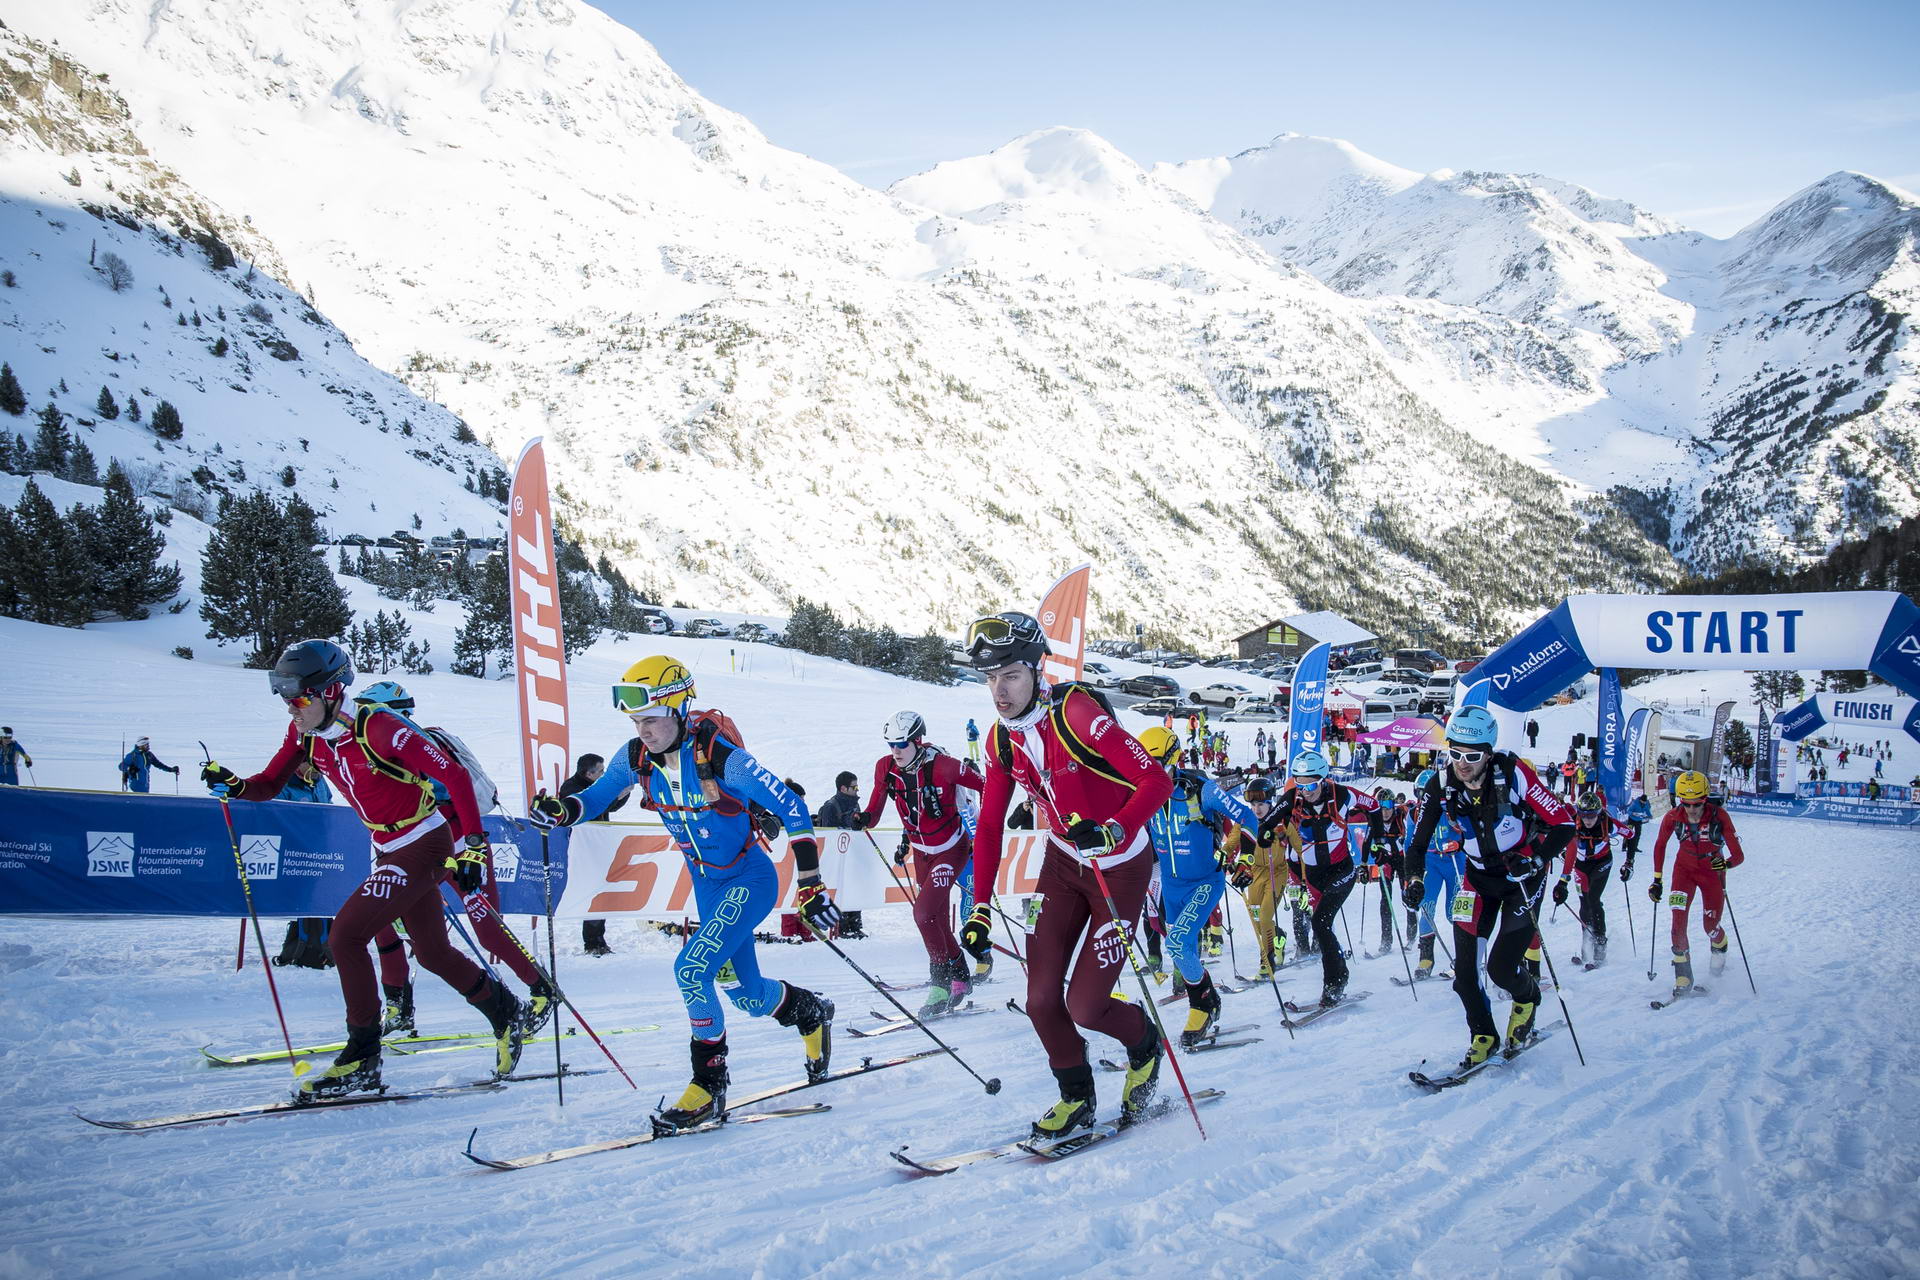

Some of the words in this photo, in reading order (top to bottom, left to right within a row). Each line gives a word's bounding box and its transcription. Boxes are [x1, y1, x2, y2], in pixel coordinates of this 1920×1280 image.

[1646, 610, 1804, 653] START
[517, 508, 567, 799] STIHL
[1511, 640, 1563, 679] Andorra
[1834, 701, 1893, 720] FINISH
[423, 744, 450, 770] Suisse
[1124, 738, 1152, 770] Suisse
[1527, 783, 1562, 816] FRANCE
[1752, 799, 1794, 809] BLANCA
[1737, 804, 1789, 814] mountaineering
[1824, 803, 1853, 812] FONT
[1857, 807, 1903, 816] BLANCA
[1841, 813, 1898, 823] mountaineering
[38, 843, 52, 852] Ski
[140, 846, 192, 856] International
[193, 847, 206, 856] Ski
[284, 848, 333, 861] International
[334, 852, 344, 861] Ski
[92, 860, 130, 873] ISMF
[138, 857, 204, 867] Mountaineering
[283, 858, 345, 872] Mountaineering
[138, 866, 181, 875] Federation
[282, 867, 323, 877] Federation
[494, 867, 515, 879] SMF
[931, 870, 955, 879] skinfit
[365, 873, 408, 887] skinfit
[933, 877, 950, 888] SUI
[361, 882, 392, 899] SUI
[1165, 883, 1213, 960] KARPOS
[1093, 927, 1133, 951] skinit
[678, 886, 749, 1006] KARPOS
[1097, 944, 1124, 969] SUI
